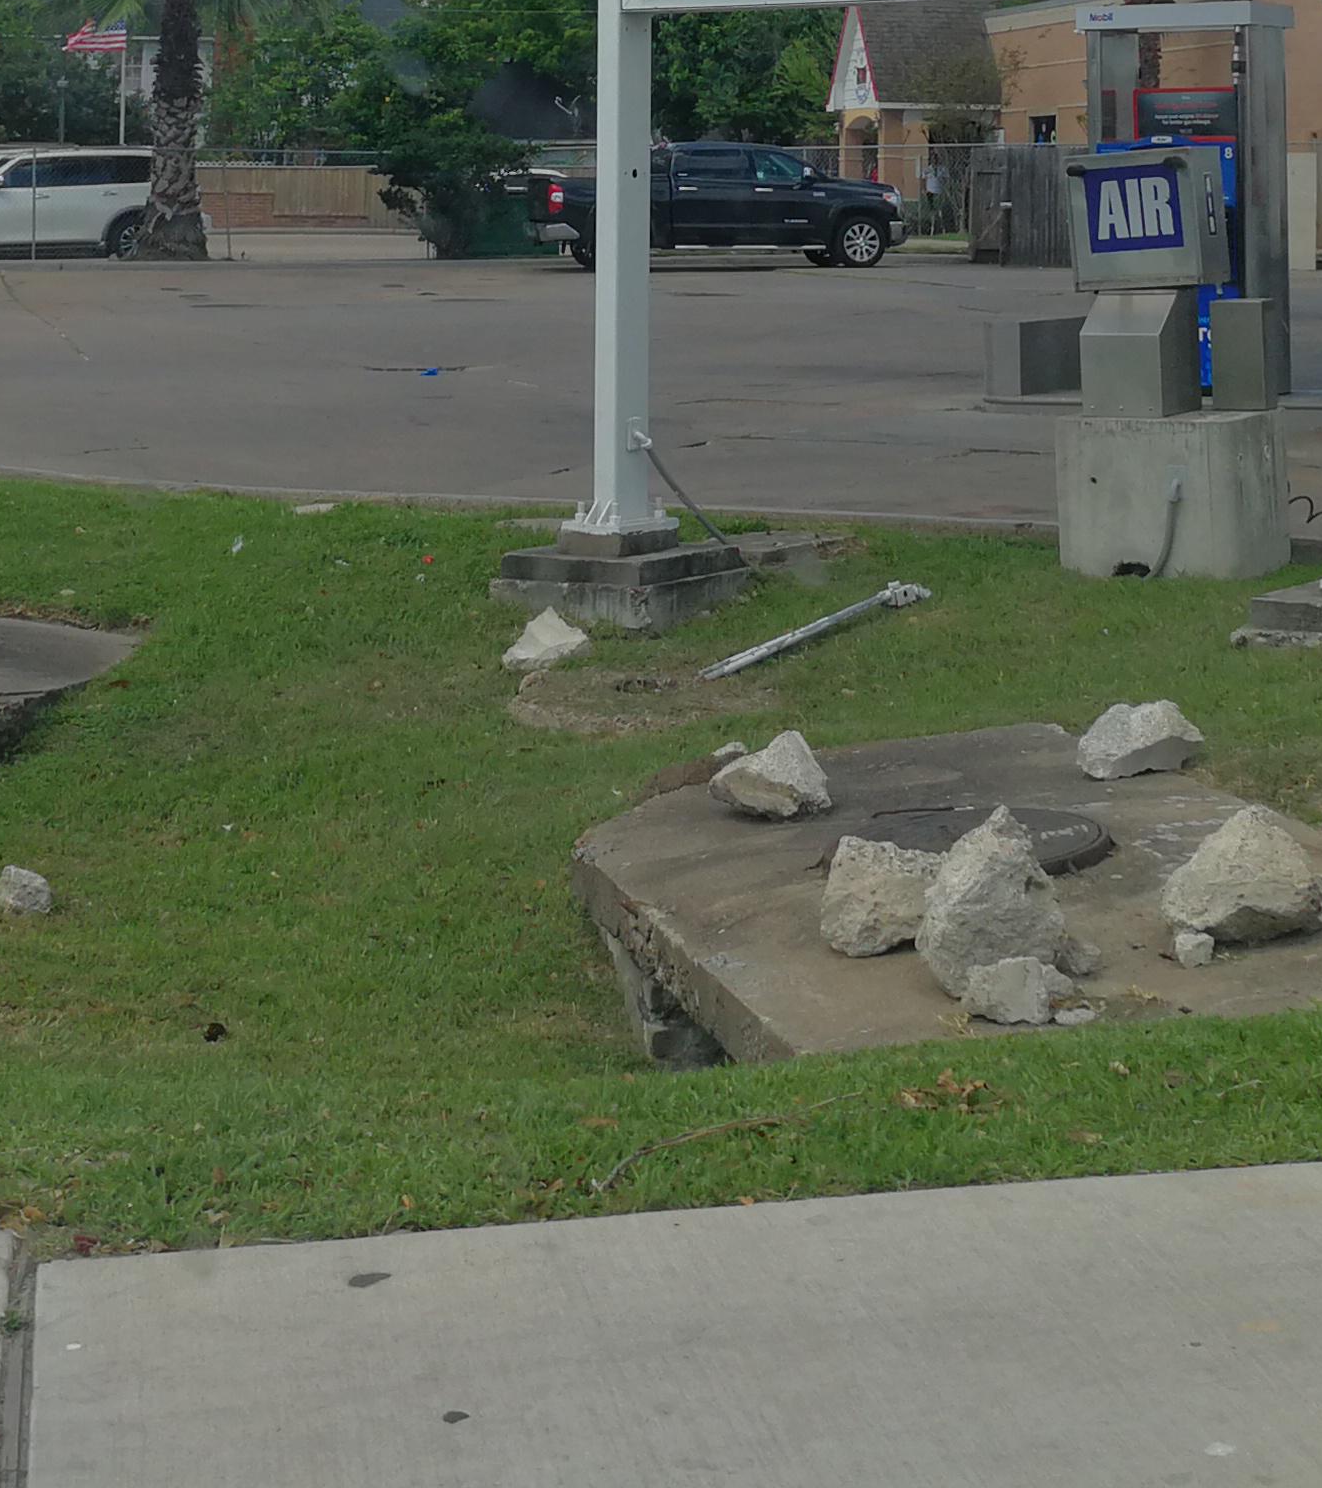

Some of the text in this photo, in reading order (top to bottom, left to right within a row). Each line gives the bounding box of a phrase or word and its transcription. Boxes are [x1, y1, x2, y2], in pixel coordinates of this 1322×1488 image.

[1089, 12, 1113, 22] Mobil
[1224, 147, 1233, 159] 8
[1097, 176, 1175, 241] AIR
